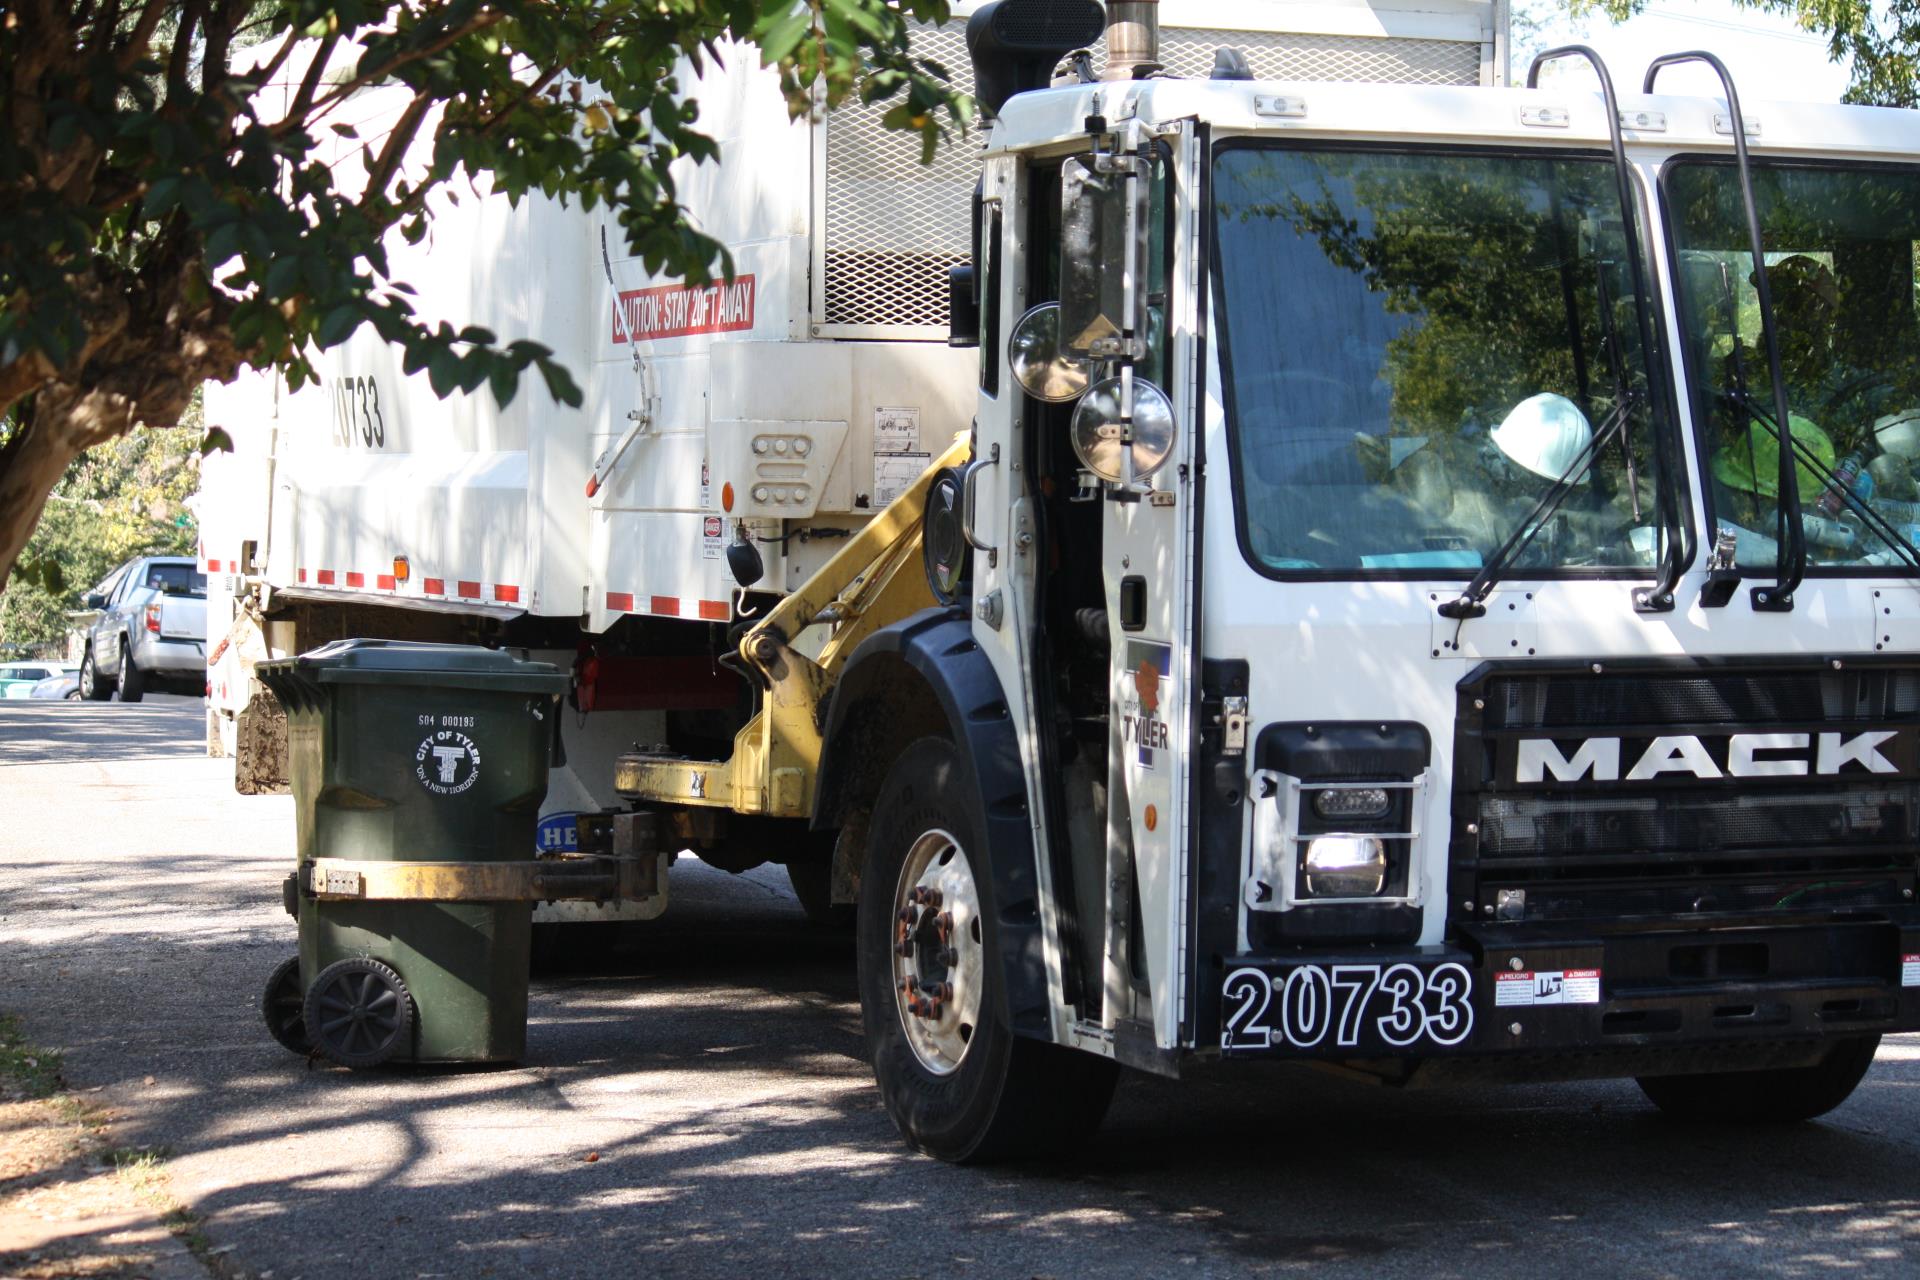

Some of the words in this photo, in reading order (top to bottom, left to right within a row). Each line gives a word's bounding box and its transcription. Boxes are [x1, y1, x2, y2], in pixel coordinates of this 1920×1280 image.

[664, 290, 691, 330] STAY
[718, 282, 752, 324] AWAY
[328, 375, 385, 448] 20733
[417, 736, 434, 760] CITY
[438, 731, 452, 740] OF
[456, 733, 480, 764] TYLER
[1124, 715, 1168, 749] TYLER
[1516, 731, 1900, 783] MACK
[430, 783, 448, 794] NEW
[1504, 972, 1529, 980] PELIGRO
[1221, 962, 1474, 1049] 20733
